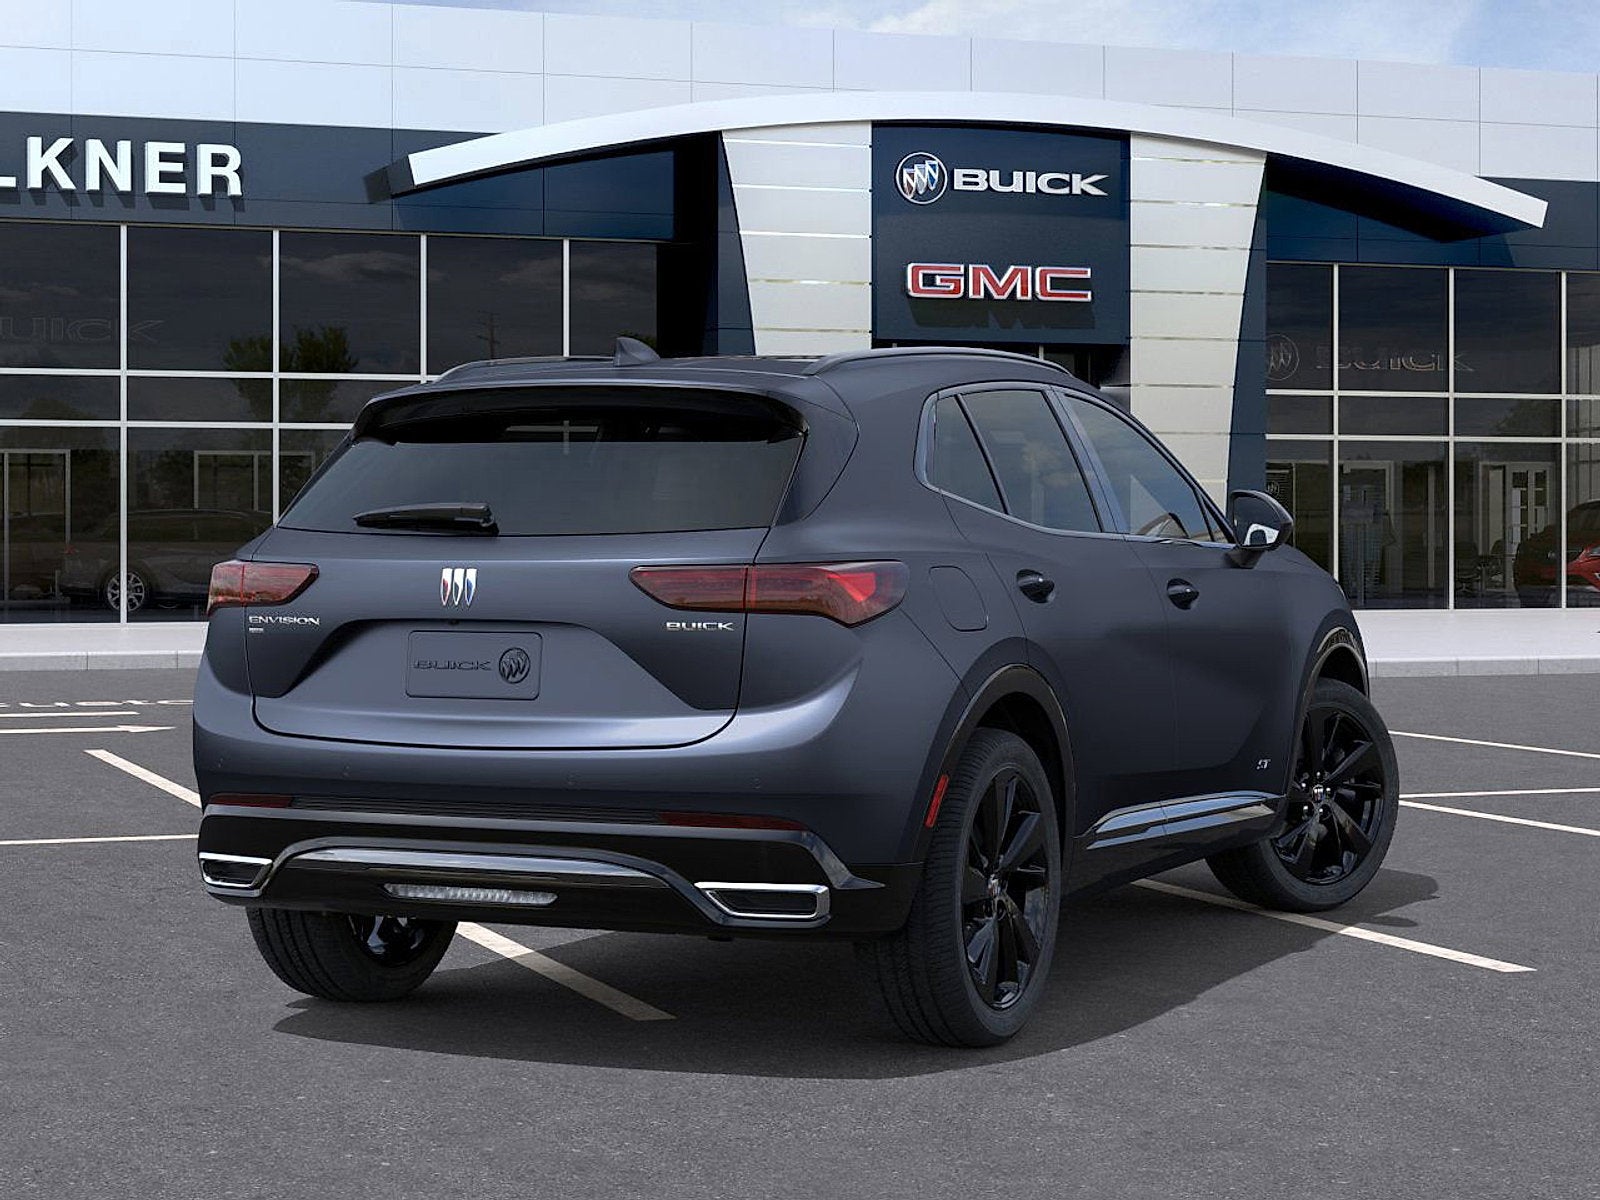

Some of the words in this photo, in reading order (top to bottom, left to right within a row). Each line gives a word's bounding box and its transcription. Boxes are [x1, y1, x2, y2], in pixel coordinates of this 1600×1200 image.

[953, 167, 1109, 197] BUICK
[907, 262, 1092, 302] GMC
[248, 615, 320, 626] ENVISION
[666, 622, 735, 632] BUICK
[413, 660, 492, 671] BUICK
